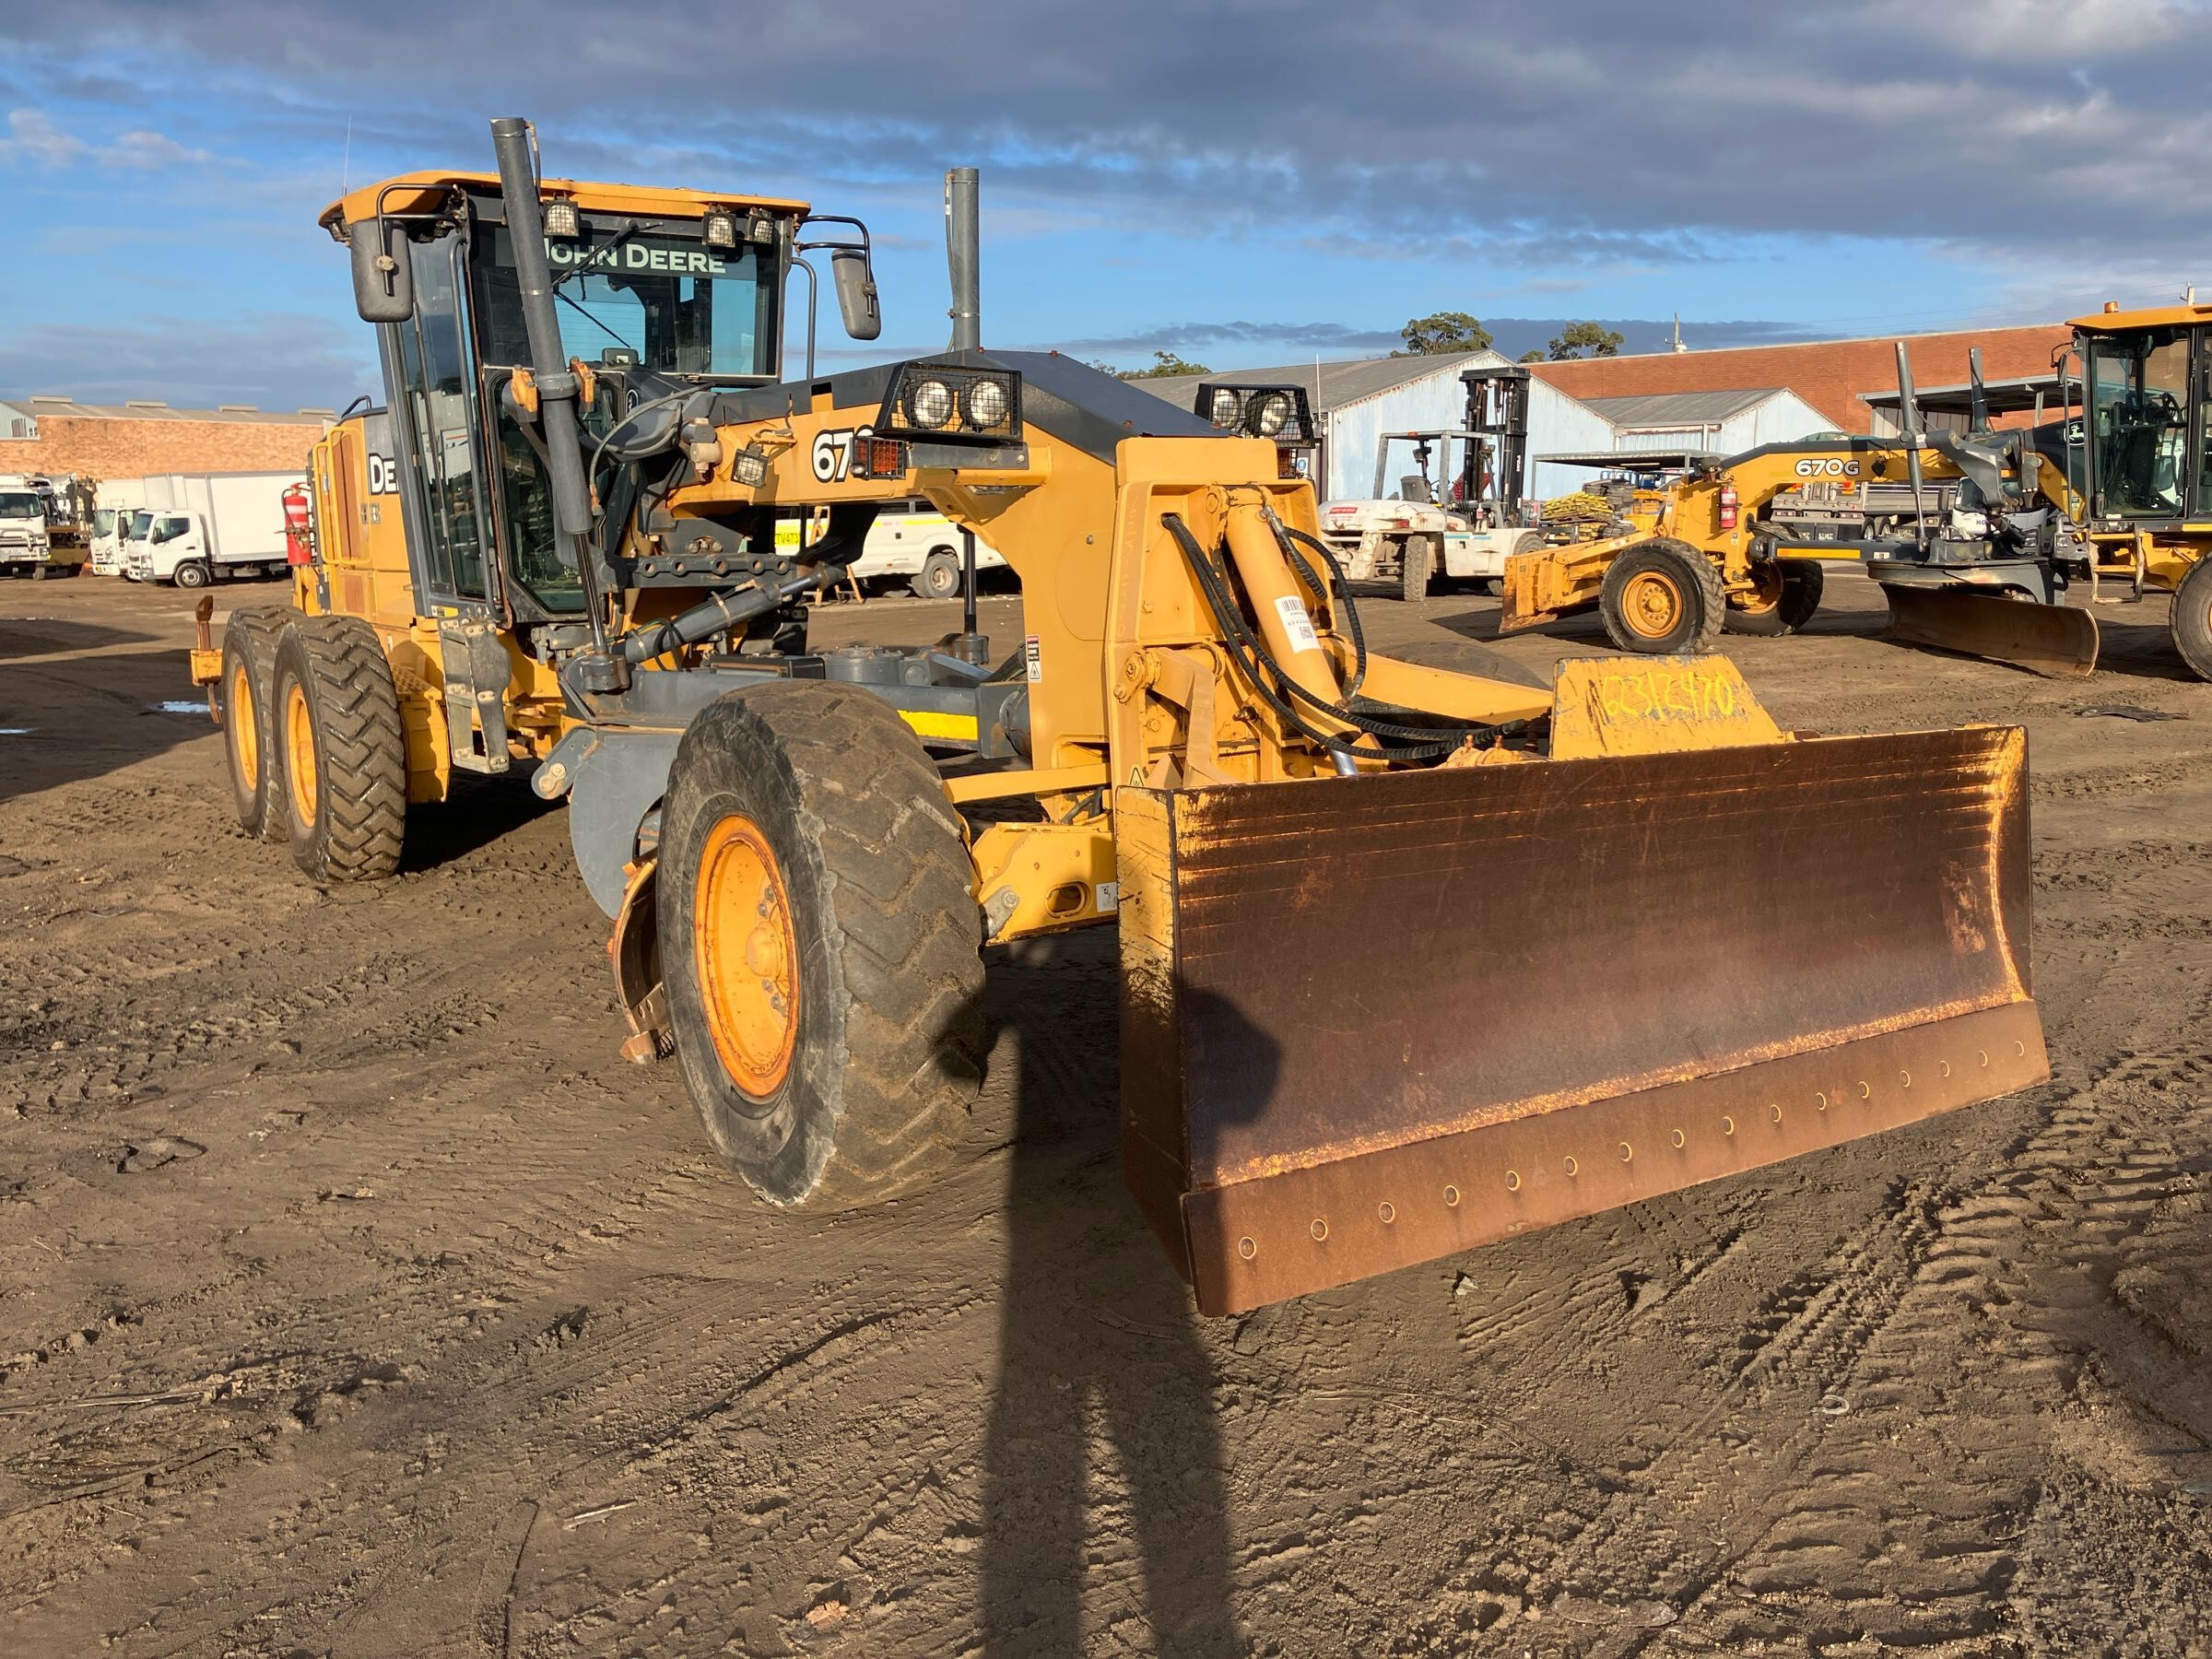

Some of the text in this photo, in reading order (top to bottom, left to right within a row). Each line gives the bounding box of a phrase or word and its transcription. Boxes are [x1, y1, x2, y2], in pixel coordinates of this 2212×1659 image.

[627, 243, 725, 274] DEERE
[812, 425, 874, 483] 67
[1794, 458, 1860, 477] 670G
[369, 453, 400, 495] DE
